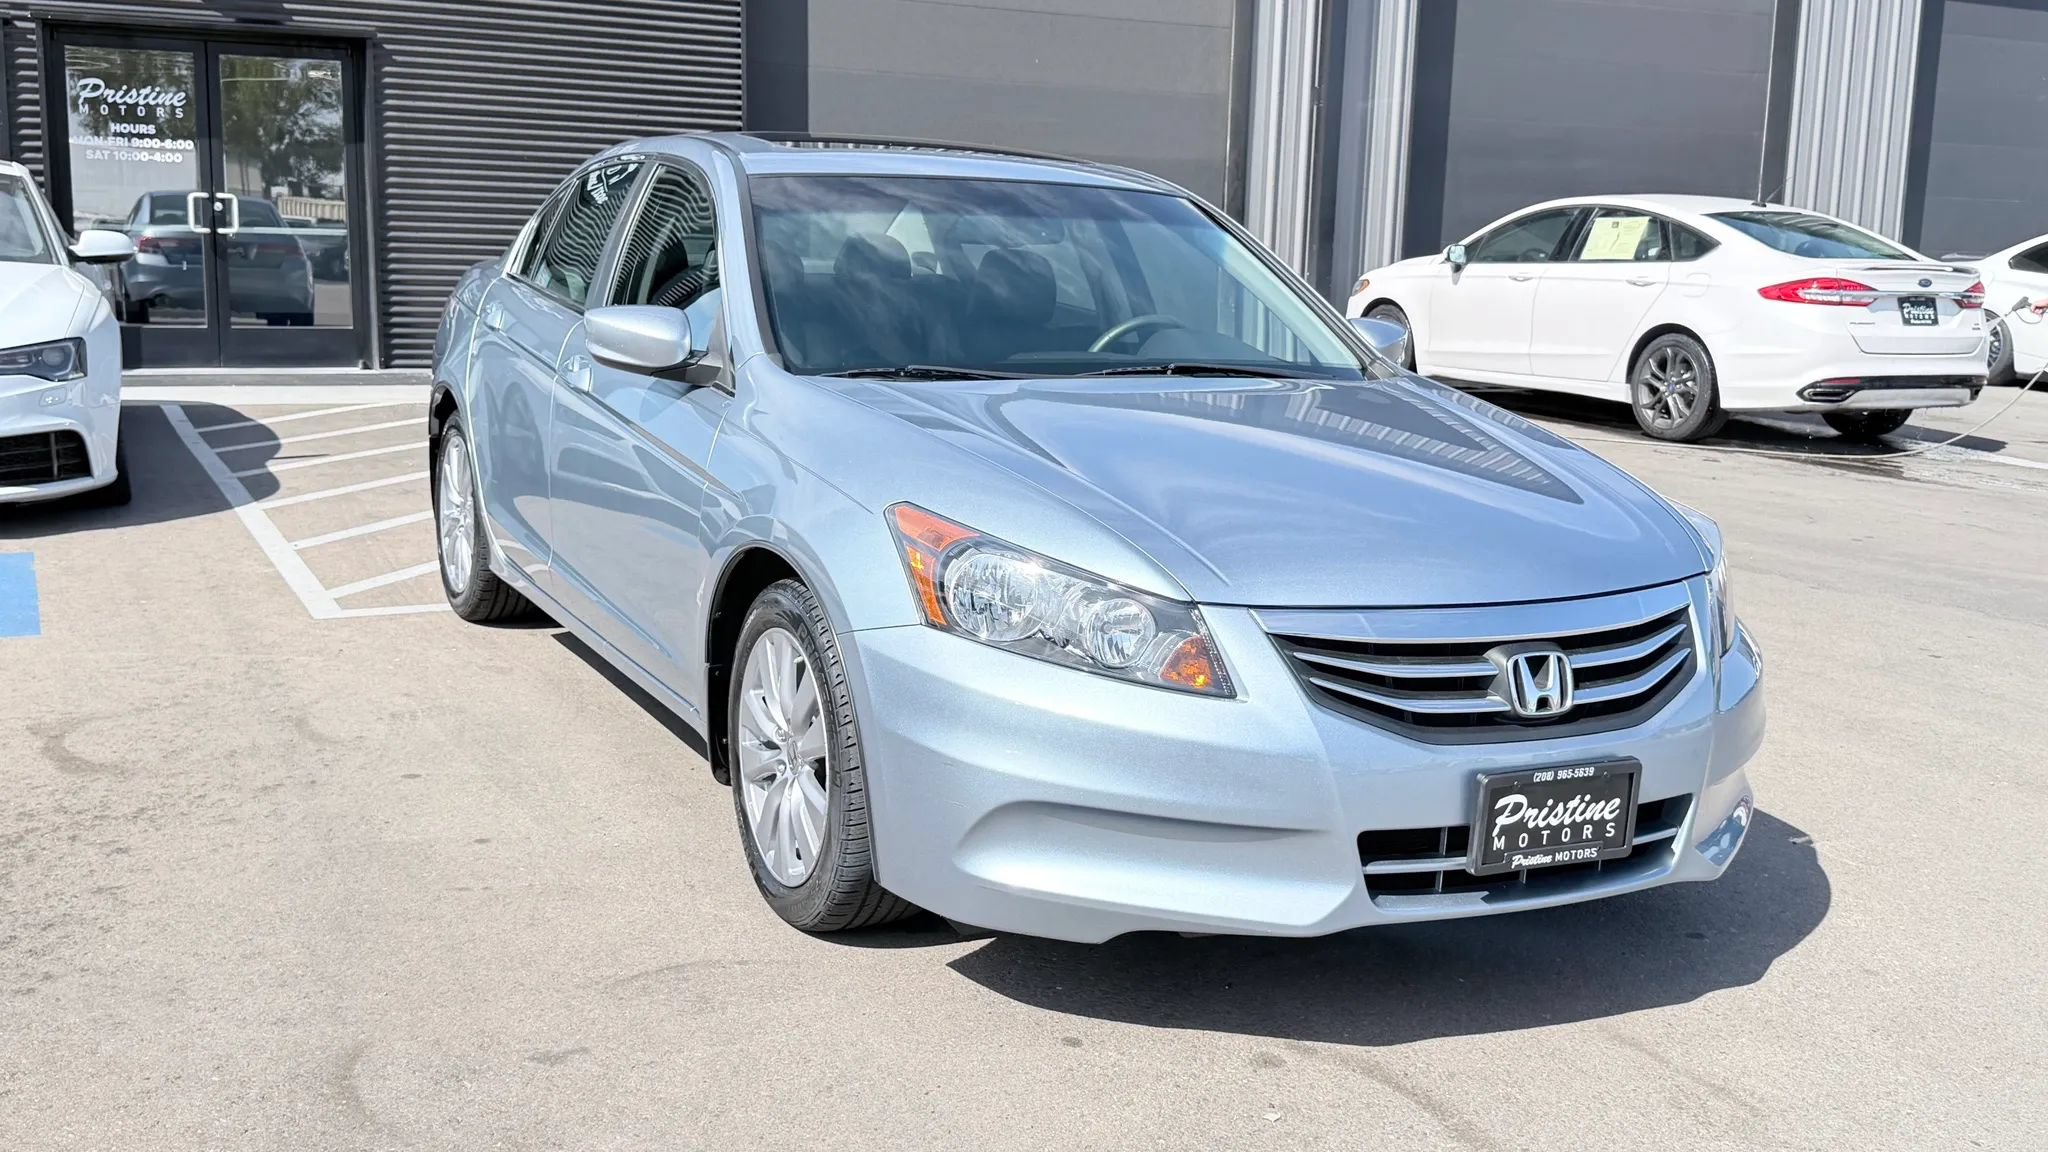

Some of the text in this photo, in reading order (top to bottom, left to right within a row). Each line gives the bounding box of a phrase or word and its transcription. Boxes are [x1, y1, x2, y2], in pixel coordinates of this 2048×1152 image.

[77, 77, 186, 106] Pristine
[79, 104, 184, 118] MOTORS
[110, 123, 157, 134] HOURS
[131, 137, 194, 150] 9:00-6:00
[86, 150, 183, 163] SAT 10:00-4:00
[1533, 766, 1595, 783] (208) 965-5639
[1492, 794, 1621, 837] Pristine
[1492, 823, 1616, 851] MOTORS
[1511, 849, 1598, 869] Pristine MOTORS
